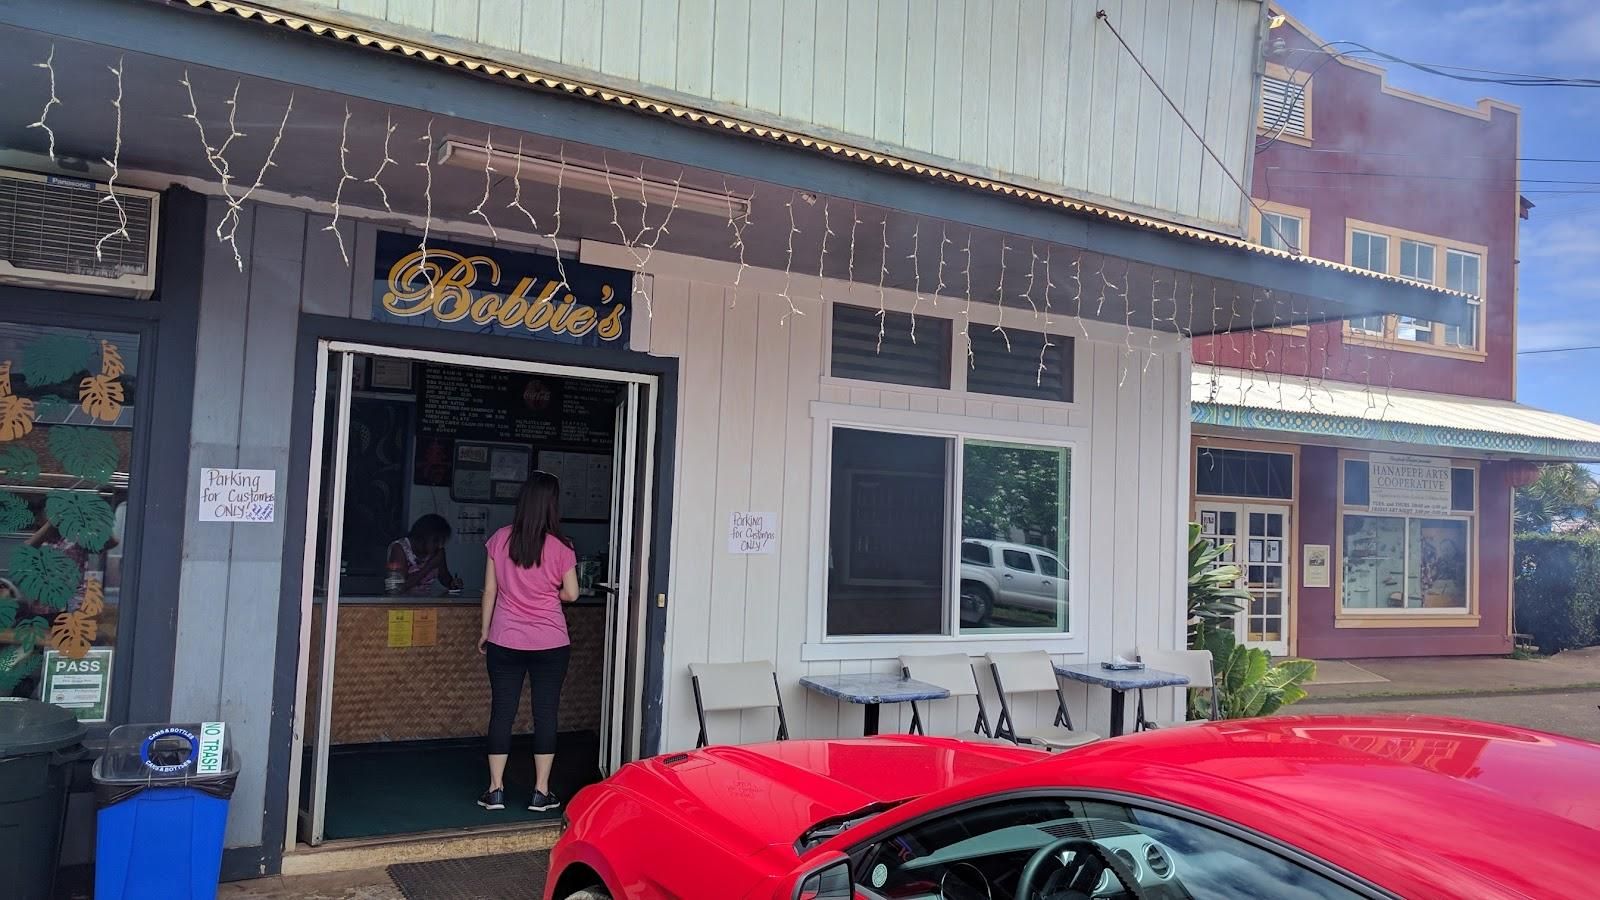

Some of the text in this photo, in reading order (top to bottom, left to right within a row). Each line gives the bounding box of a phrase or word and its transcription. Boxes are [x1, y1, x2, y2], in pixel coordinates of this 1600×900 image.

[52, 177, 91, 189] Panasonic
[382, 249, 625, 341] Bobbie's
[207, 470, 260, 492] Parking
[1425, 469, 1449, 480] ARTS
[1377, 477, 1445, 490] COOPERATIVE
[201, 488, 220, 502] for
[732, 511, 763, 532] Parking
[731, 526, 743, 540] for
[55, 661, 100, 672] PASS
[148, 730, 165, 741] CANS
[170, 727, 195, 740] BOTTLES
[201, 739, 220, 771] TRASH
